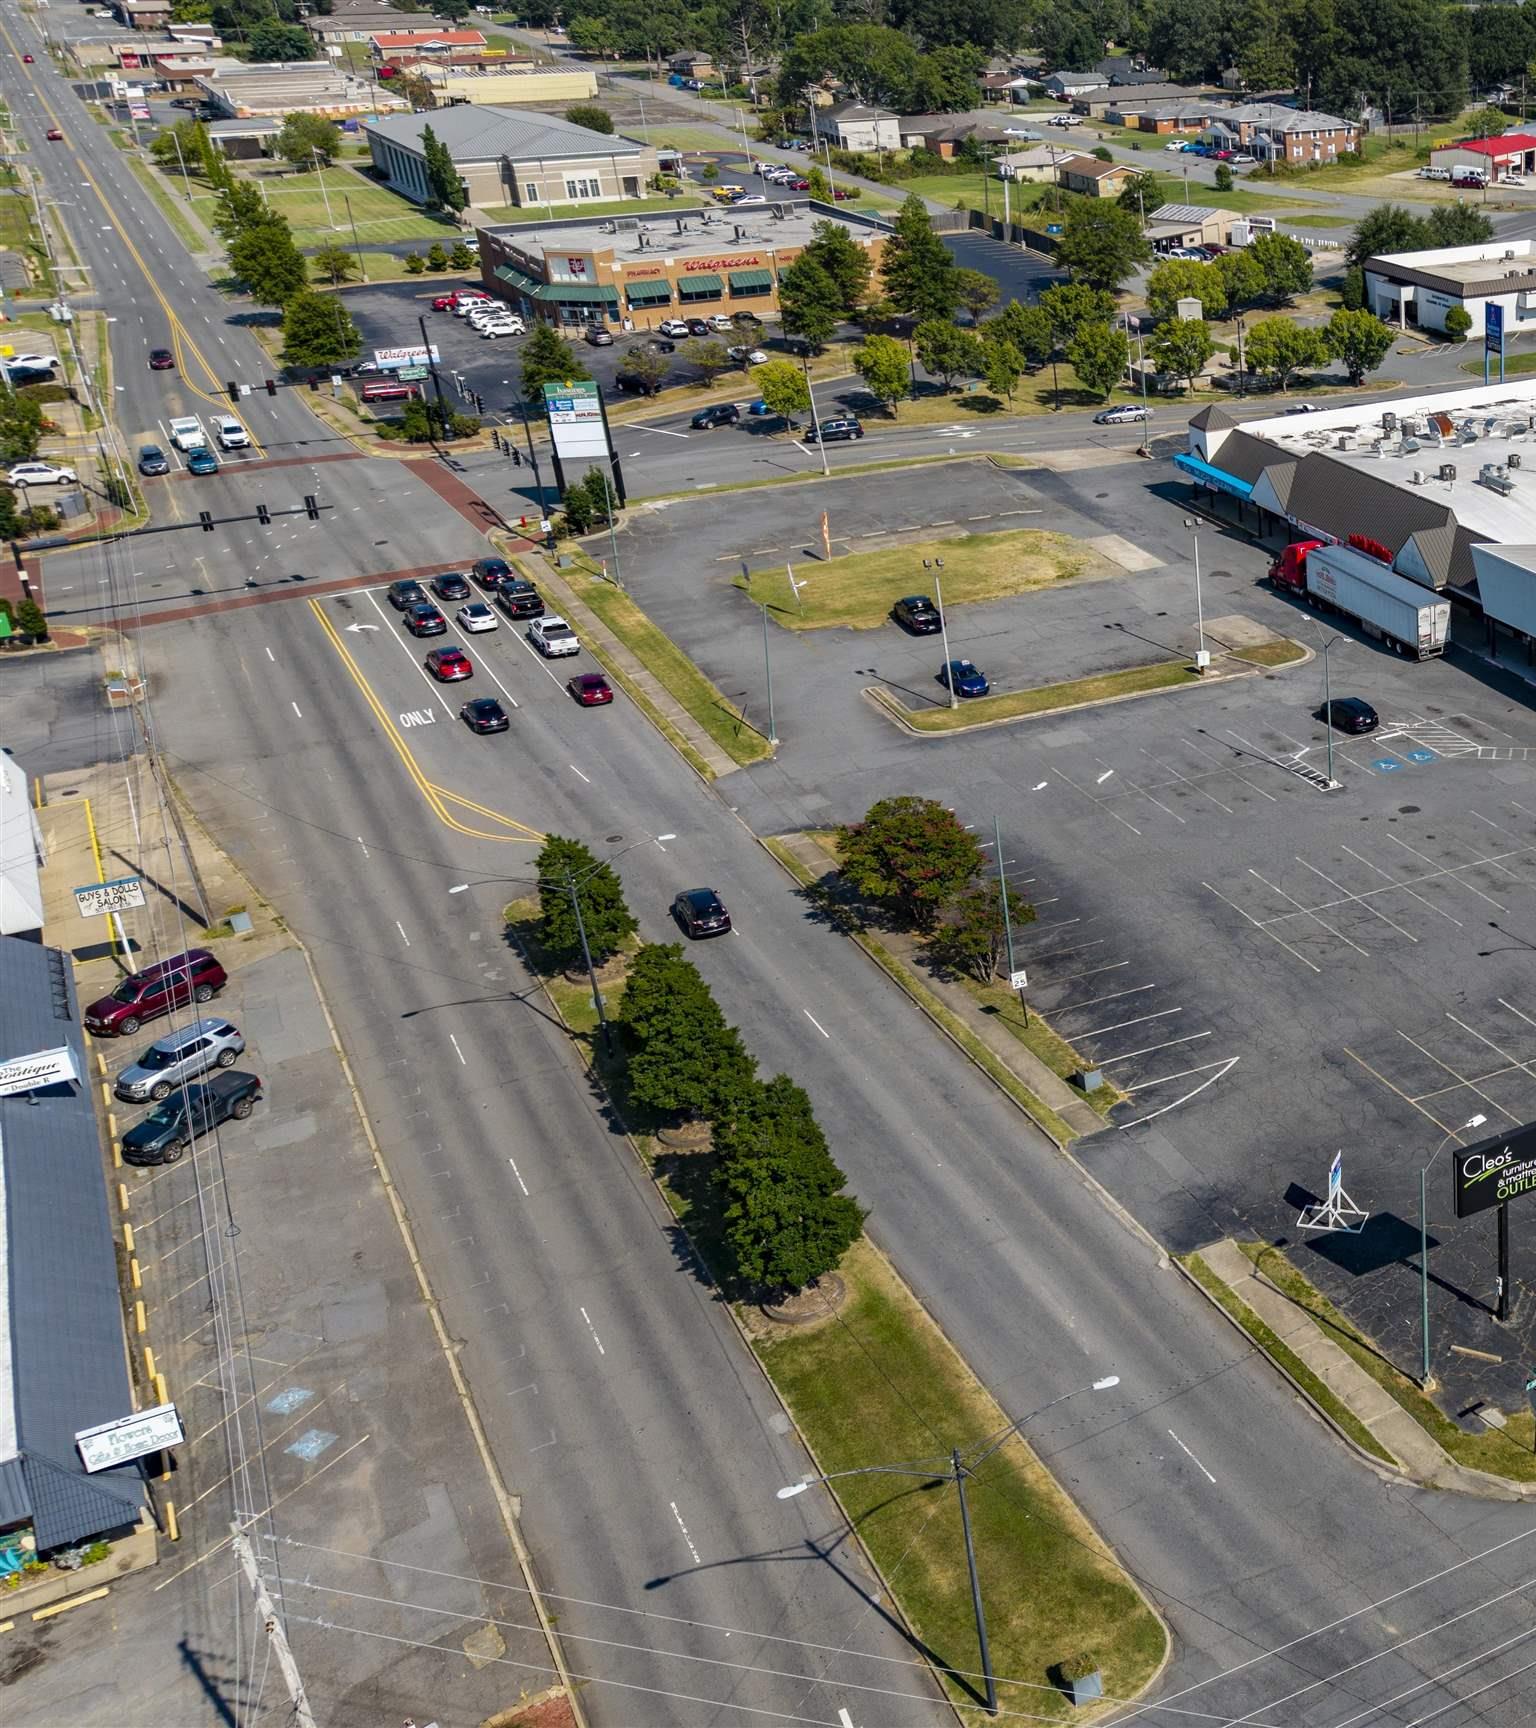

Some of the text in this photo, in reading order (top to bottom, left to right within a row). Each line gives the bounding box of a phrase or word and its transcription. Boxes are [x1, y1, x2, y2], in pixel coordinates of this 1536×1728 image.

[627, 268, 660, 278] PHARMACY
[683, 257, 759, 272] Walgreens
[400, 708, 435, 727] ONLY
[79, 882, 139, 903] GUYS & DOLLS
[97, 895, 127, 908] SALON
[3, 1066, 21, 1074] The
[1463, 1146, 1513, 1178] Cleo's
[108, 1425, 152, 1446] Flowers
